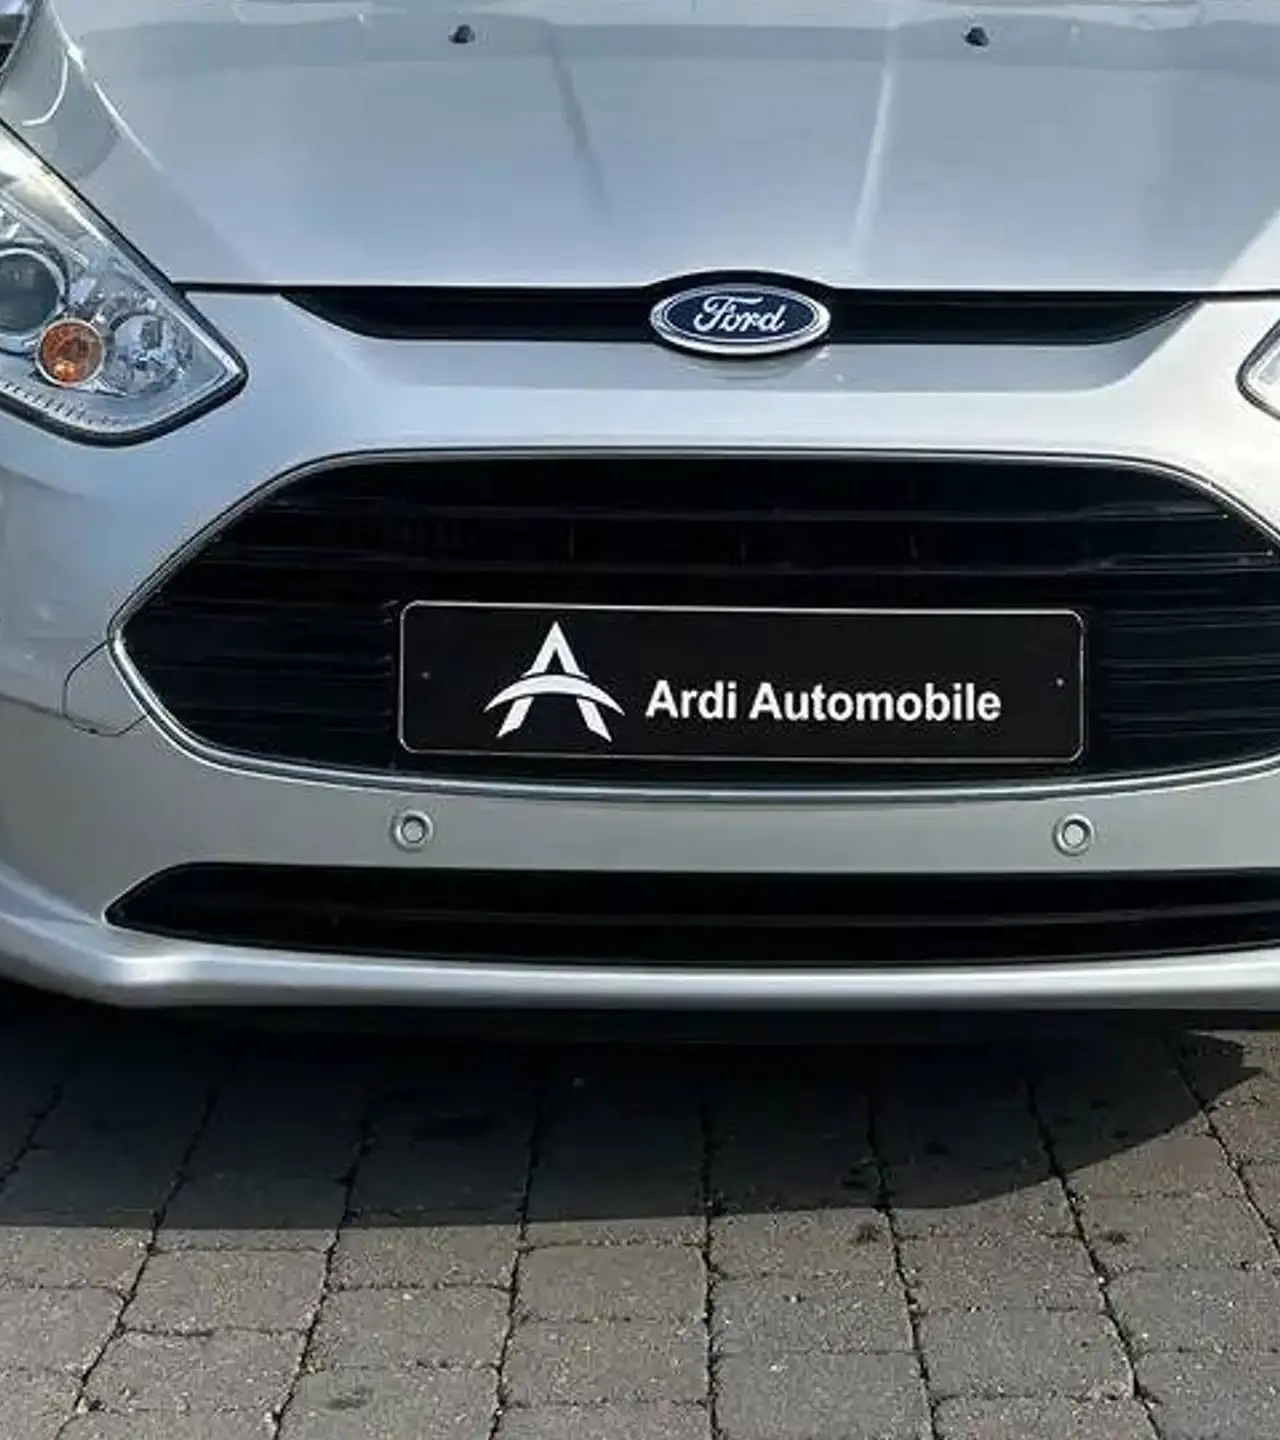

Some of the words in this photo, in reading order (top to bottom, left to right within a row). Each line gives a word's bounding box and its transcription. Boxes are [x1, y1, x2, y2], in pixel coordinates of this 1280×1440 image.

[692, 295, 787, 334] Ford
[644, 678, 738, 721] Ardi
[748, 681, 1002, 723] Automobile
